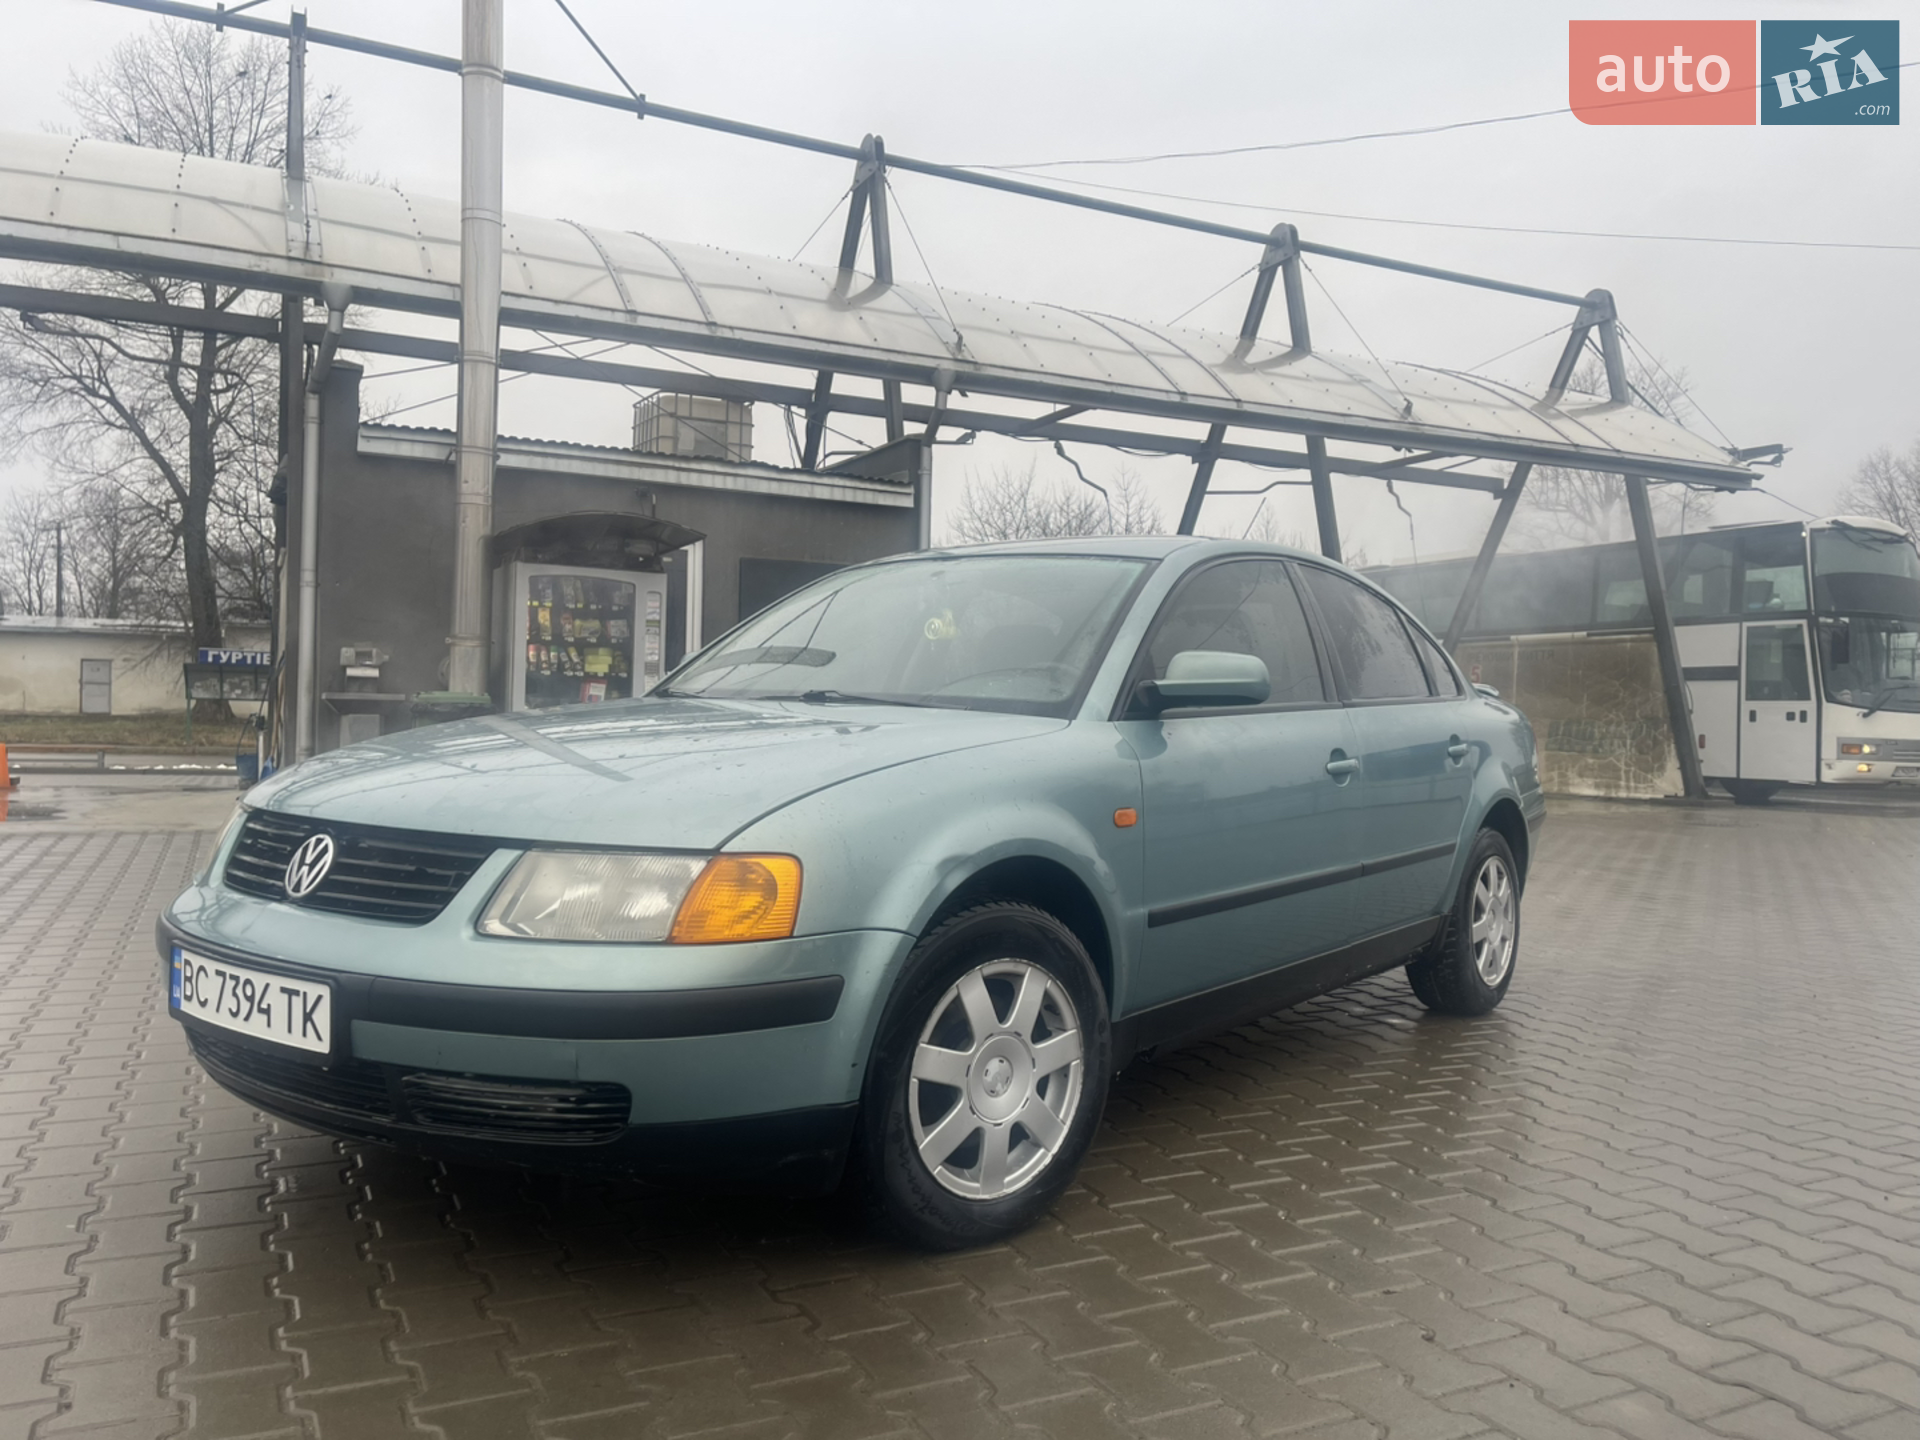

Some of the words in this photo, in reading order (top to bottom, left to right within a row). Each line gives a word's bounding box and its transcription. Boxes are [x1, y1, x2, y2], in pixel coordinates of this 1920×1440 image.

[183, 958, 209, 1008] BC
[214, 968, 272, 1029] 7394
[279, 985, 324, 1042] TK
